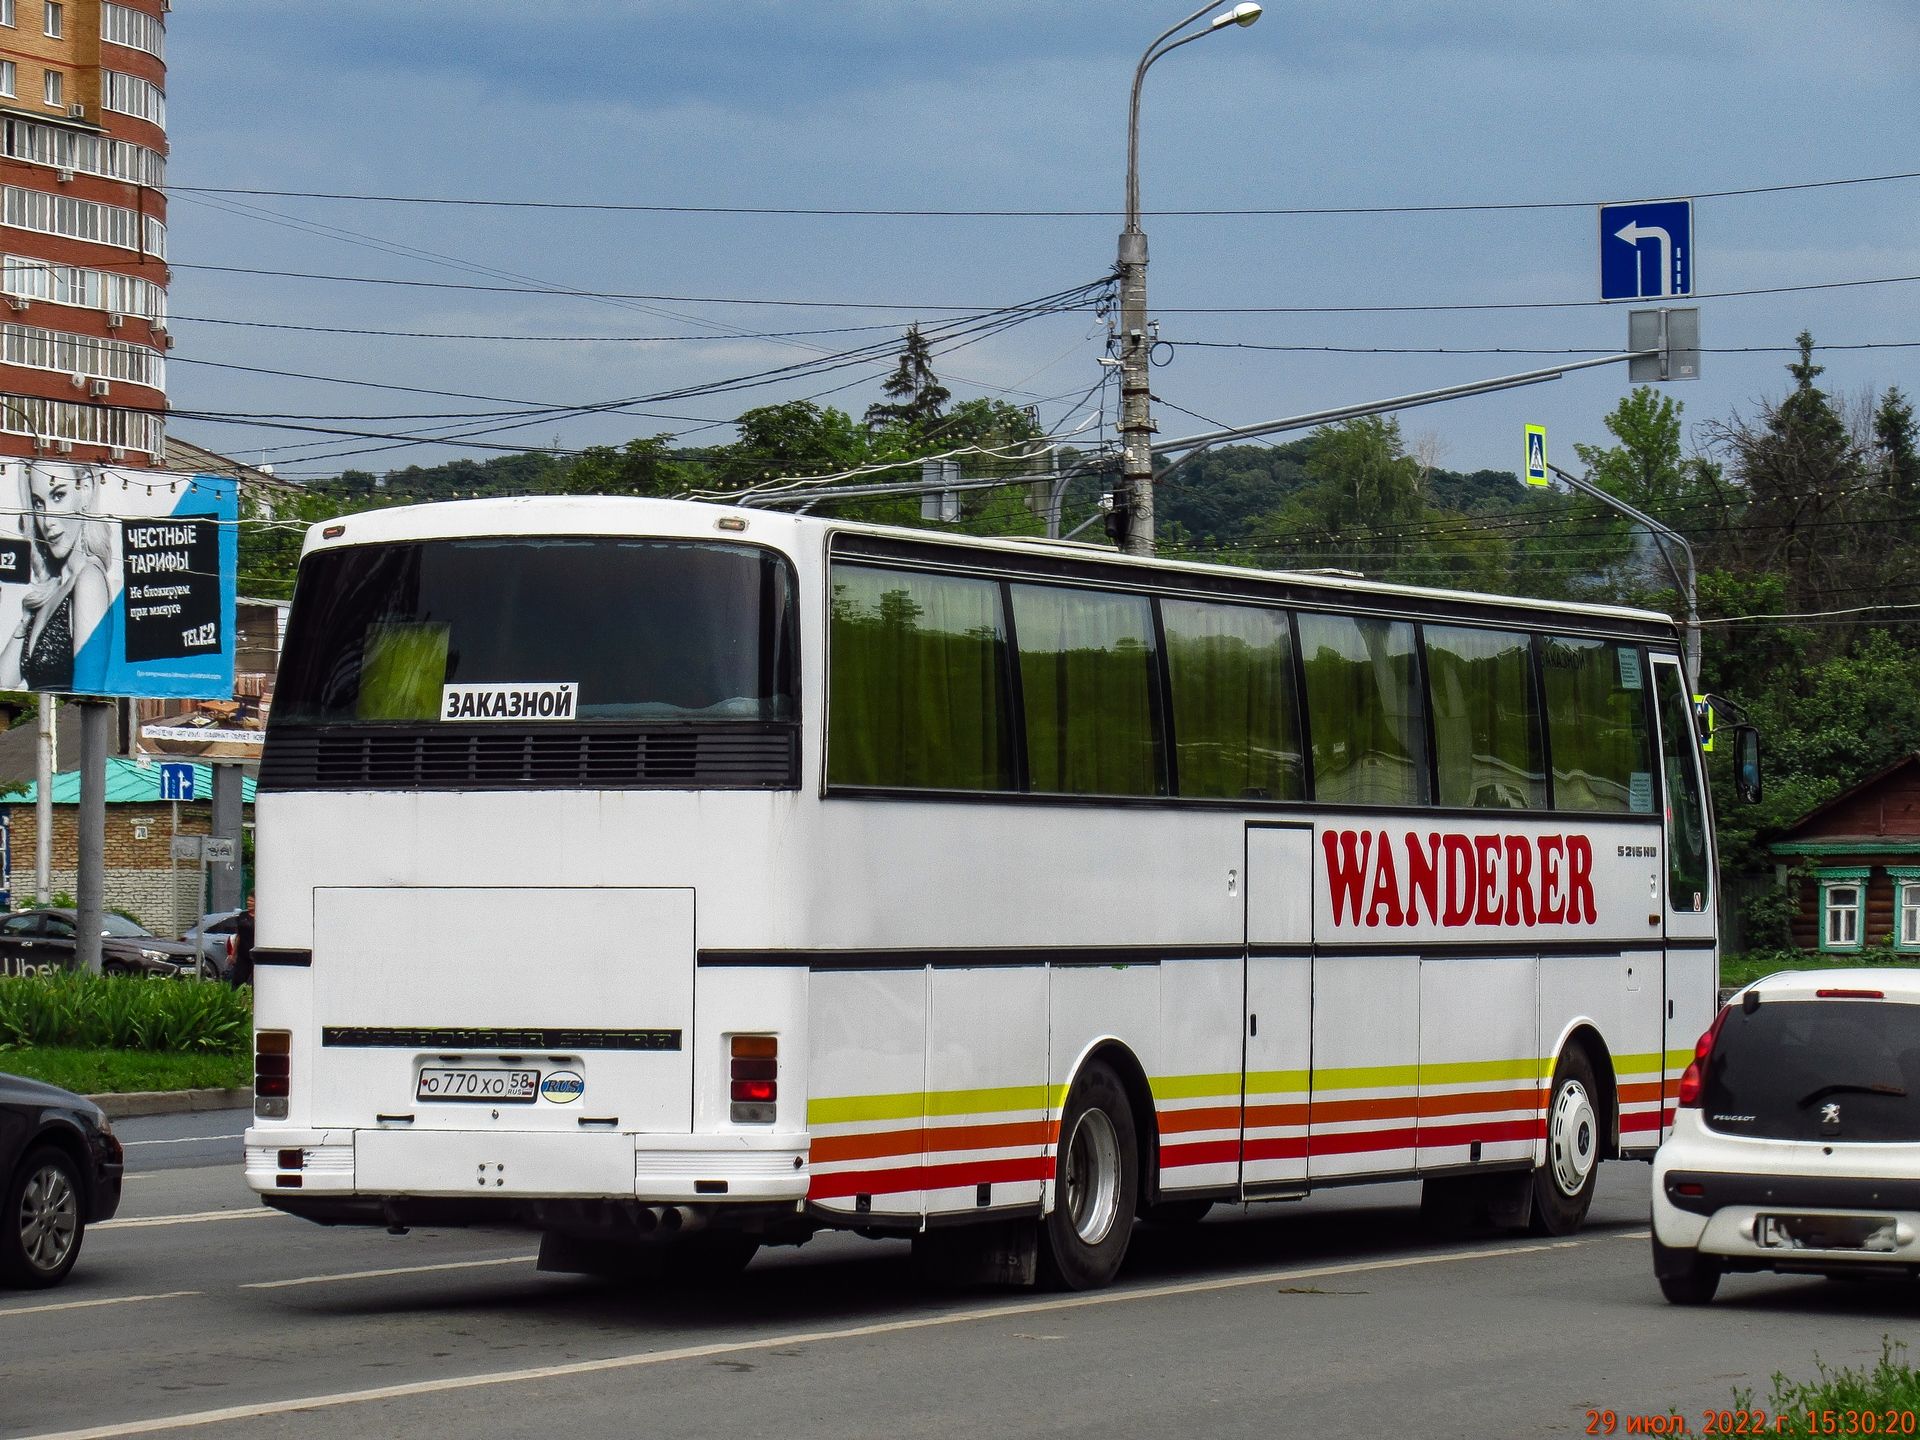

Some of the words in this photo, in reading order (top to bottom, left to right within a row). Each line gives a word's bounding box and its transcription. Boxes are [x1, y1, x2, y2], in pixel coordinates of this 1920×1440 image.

[128, 525, 196, 548] ЧЕСТНЫЕ
[128, 551, 189, 574] ТАРИФЫ
[130, 586, 142, 599] Не
[130, 607, 148, 621] при
[182, 622, 217, 647] TELE2
[447, 685, 572, 718] ЗАКАЗНОЙ
[1321, 829, 1598, 928] WANDERER
[510, 1073, 529, 1088] 58
[545, 1079, 580, 1093] RUS
[1713, 1114, 1756, 1122] PEUGEOT
